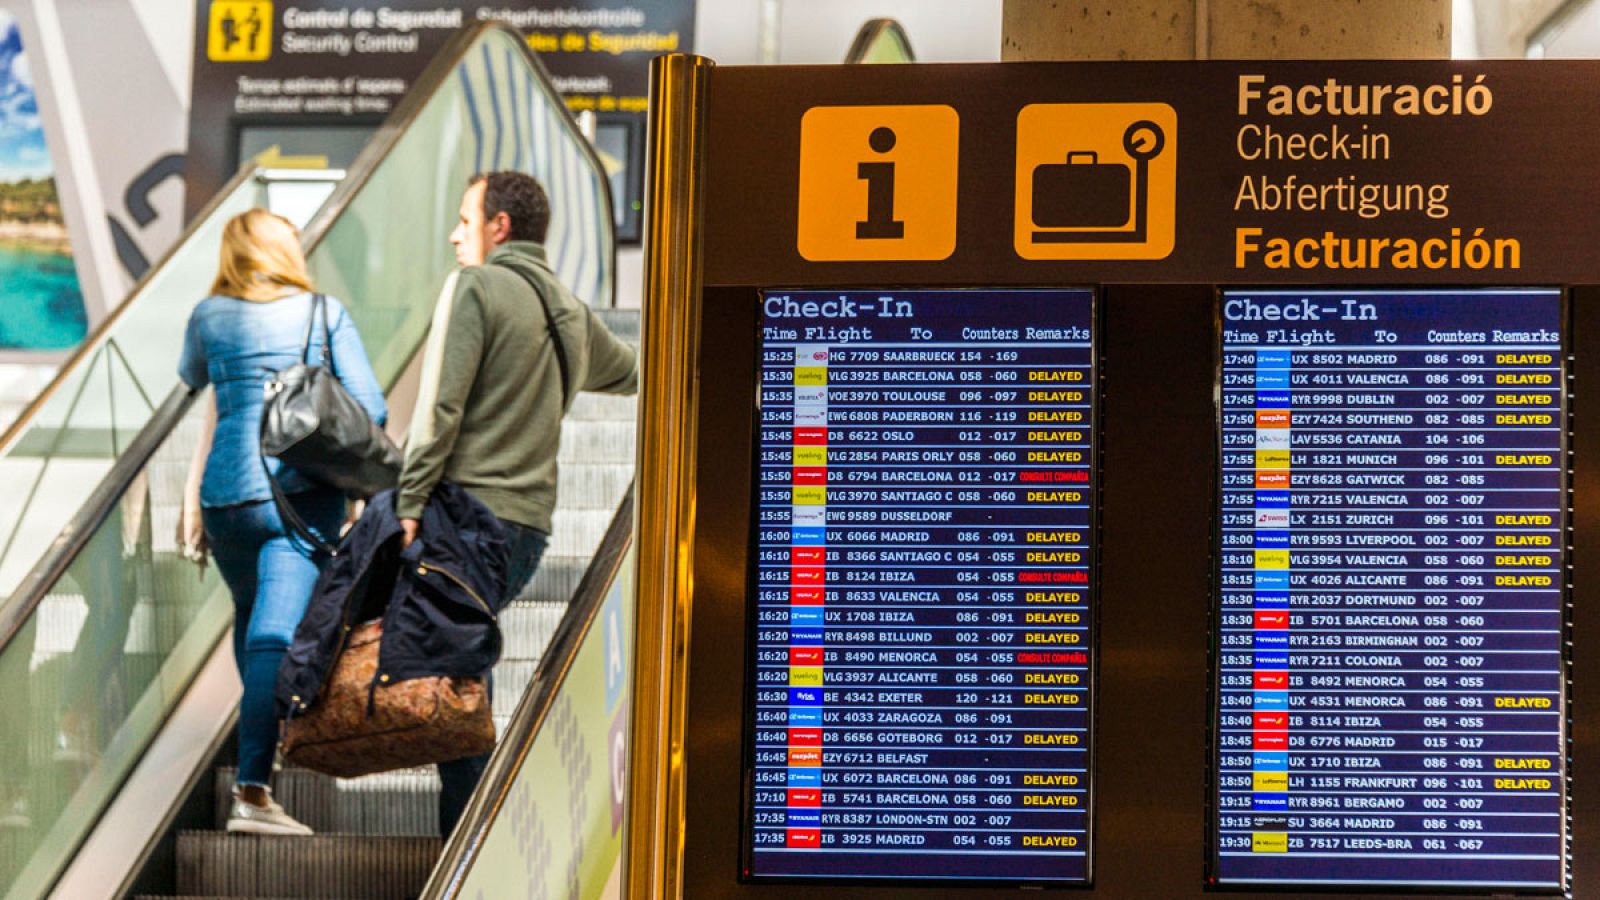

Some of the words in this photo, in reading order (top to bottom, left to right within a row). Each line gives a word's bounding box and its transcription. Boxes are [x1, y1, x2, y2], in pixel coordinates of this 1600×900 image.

[282, 31, 351, 56] Security
[354, 31, 418, 53] Control
[1237, 74, 1494, 117] Facturació
[1236, 124, 1391, 162] Check-in
[1234, 174, 1450, 219] Abfertigung
[1235, 226, 1522, 271] Facturación
[764, 296, 914, 319] Check-In
[1223, 299, 1379, 322] Check-In
[763, 328, 798, 341] Time
[804, 327, 873, 343] Flight
[910, 328, 933, 341] To
[962, 327, 1019, 341] Counters
[1025, 327, 1091, 341] Remarks
[1223, 330, 1260, 344] Time
[1266, 329, 1337, 347] Flight
[1374, 330, 1398, 344] To
[1427, 330, 1487, 344] Counters
[1492, 330, 1560, 344] Remarks
[763, 351, 794, 362] 15:25
[850, 351, 880, 361] 7709
[883, 351, 956, 361] SAARBRUECK
[959, 351, 982, 361] 154
[1223, 414, 1255, 425] 17:50
[1312, 414, 1343, 425] 7424
[1346, 414, 1414, 425] SOUTHEND
[1424, 414, 1449, 425] 082
[1495, 414, 1553, 425] DELAYED
[761, 431, 793, 441] 15:45
[848, 431, 879, 441] 6622
[881, 431, 915, 441] OSLO
[958, 431, 982, 441] 012
[1027, 431, 1083, 441] DELAYED
[1223, 454, 1255, 465] 17:55
[1312, 454, 1342, 465] 1821
[1346, 454, 1397, 465] MUNICH
[1424, 454, 1449, 465] 096
[1495, 455, 1553, 465] DELAYED
[761, 471, 792, 481] 15:50
[847, 471, 878, 481] 6794
[881, 471, 953, 481] BARCELONA
[958, 471, 981, 482] 012
[1222, 514, 1254, 525] 17:55
[1311, 514, 1342, 525] 2151
[1345, 514, 1394, 525] ZURICH
[1424, 514, 1449, 525] 096
[1495, 515, 1552, 525] DELAYED
[759, 531, 791, 541] 16:00
[847, 531, 877, 541] 6066
[880, 531, 930, 542] MADRID
[957, 531, 980, 542] 086
[1026, 532, 1081, 543] DELAYED
[1222, 534, 1254, 545] 18:00
[1311, 534, 1343, 545] 9593
[1345, 535, 1417, 545] LIVERPOOL
[1424, 535, 1449, 545] 002
[1495, 535, 1552, 546] DELAYED
[759, 611, 789, 621] 16:20
[846, 611, 876, 622] 1708
[879, 611, 915, 622] IBIZA
[955, 612, 979, 623] 086
[1025, 612, 1080, 623] DELAYED
[1221, 615, 1253, 625] 18:30
[1311, 615, 1342, 626] 5701
[1345, 615, 1420, 626] BARCELONA
[1423, 615, 1448, 626] 058
[757, 671, 788, 682] 16:20
[844, 671, 875, 682] 3937
[877, 672, 938, 683] ALICANTE
[955, 672, 978, 683] 058
[1024, 673, 1080, 684] DELAYED
[1220, 695, 1253, 706] 18:40
[1310, 695, 1341, 707] 4531
[1344, 696, 1406, 707] MENORCA
[1423, 696, 1448, 708] 086
[1494, 697, 1552, 708] DELAYED
[756, 731, 787, 742] 16:40
[843, 732, 874, 743] 6656
[877, 732, 943, 744] GOTEBORG
[954, 733, 978, 744] 012
[1023, 734, 1079, 745] DELAYED
[1220, 756, 1252, 767] 18:50
[1310, 756, 1341, 768] 1710
[1343, 756, 1381, 768] IBIZA
[1423, 757, 1448, 769] 086
[1494, 758, 1552, 769] DELAYED
[1219, 816, 1252, 828] 19:15
[1309, 817, 1341, 829] 3664
[1343, 818, 1396, 829] MADRID
[1423, 818, 1448, 829] 086
[754, 832, 785, 844] 17:35
[842, 833, 872, 845] 3925
[875, 834, 925, 845] MADRID
[952, 835, 976, 846] 054
[1023, 835, 1078, 847] DELAYED
[1219, 836, 1252, 848] 19:30
[1309, 837, 1341, 849] 7517
[1343, 838, 1413, 850] LEEDS-BRA
[1423, 838, 1447, 850] 061
